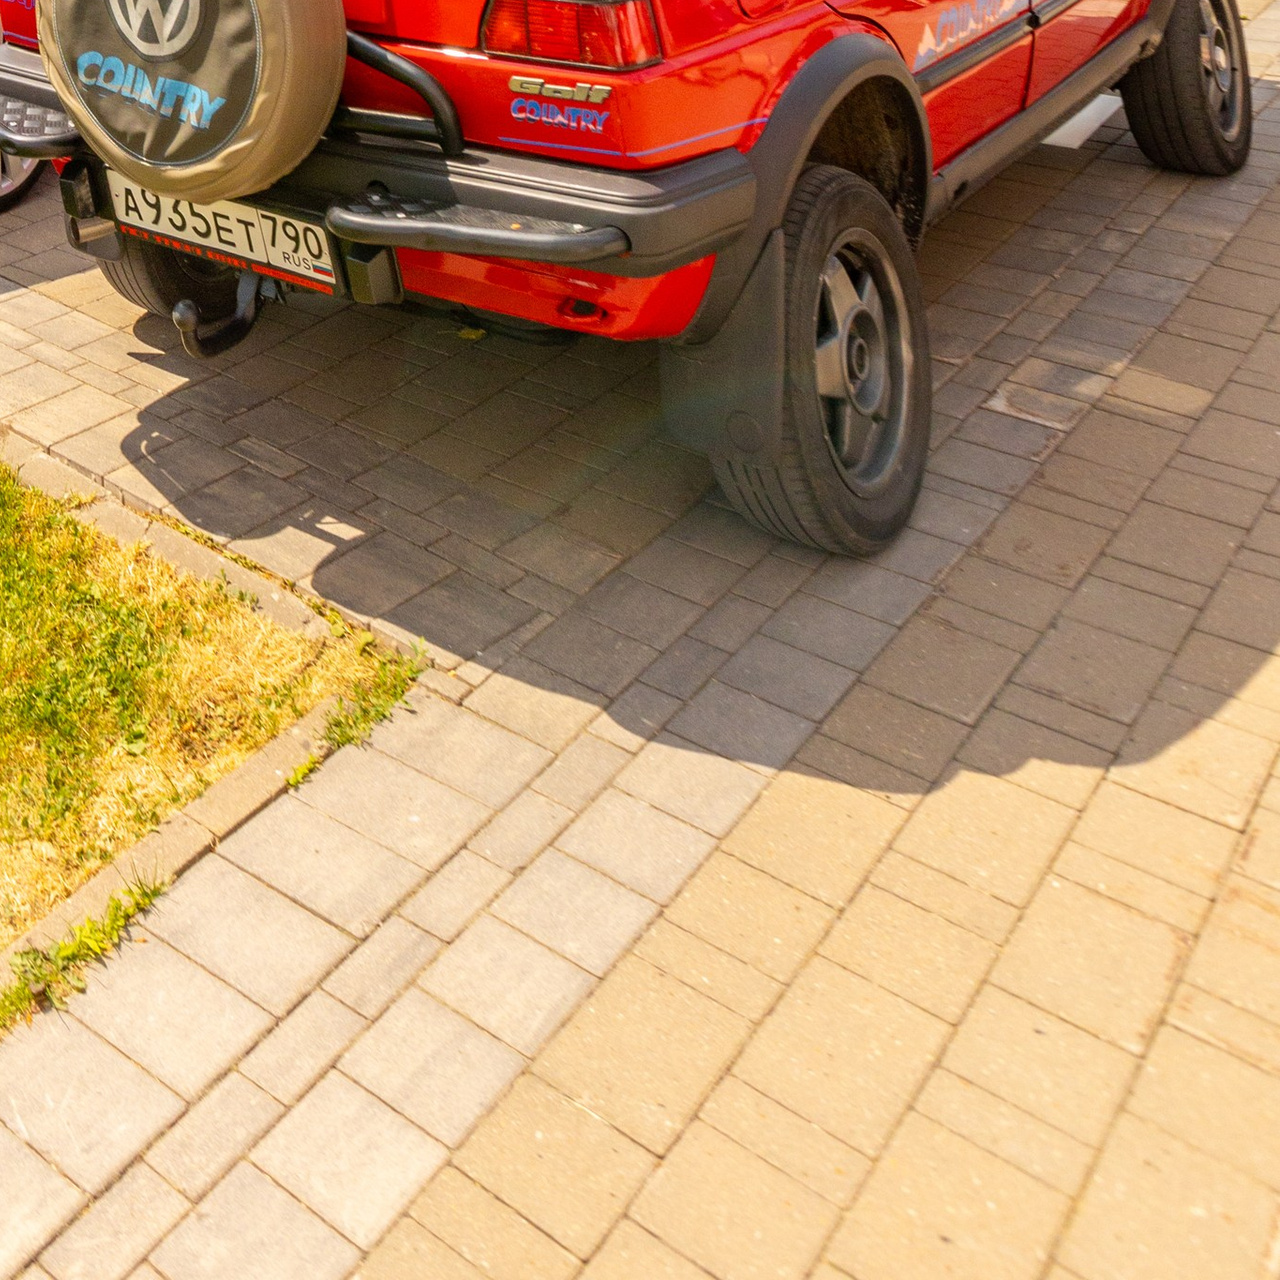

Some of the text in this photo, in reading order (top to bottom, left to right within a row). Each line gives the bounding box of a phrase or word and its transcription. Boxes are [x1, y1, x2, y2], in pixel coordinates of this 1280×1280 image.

[77, 50, 227, 130] COUNTRY
[508, 75, 612, 104] Golf
[511, 98, 610, 133] COUNTRY
[261, 213, 323, 260] 790
[282, 251, 312, 271] RUS
